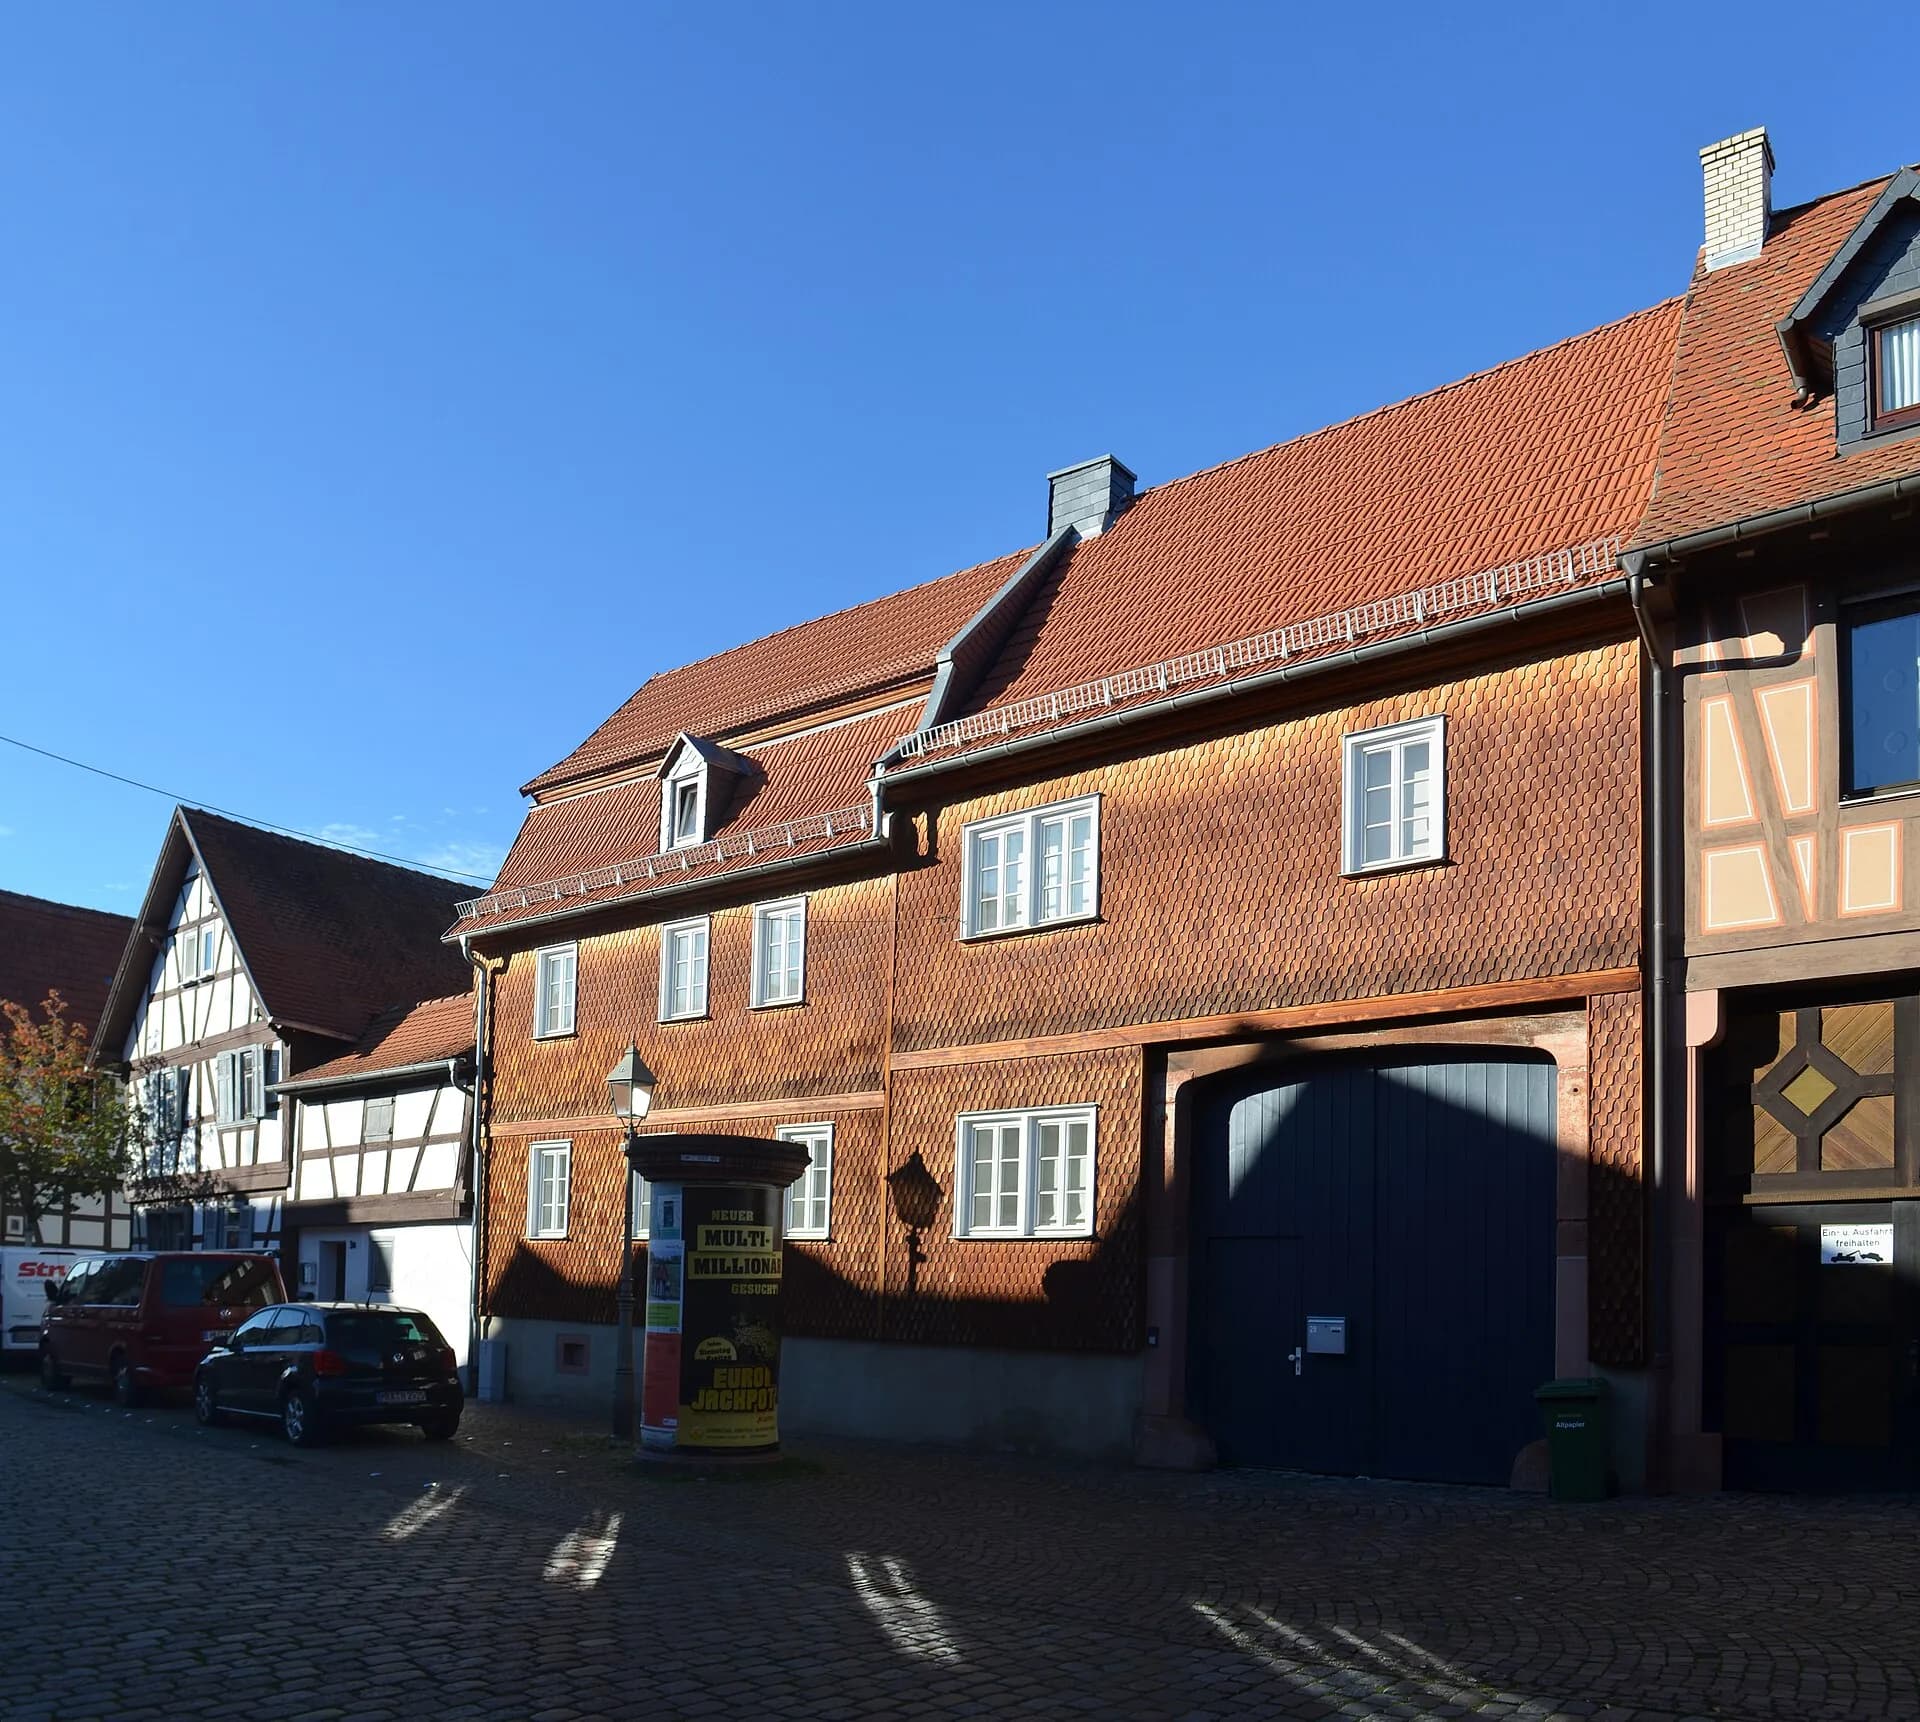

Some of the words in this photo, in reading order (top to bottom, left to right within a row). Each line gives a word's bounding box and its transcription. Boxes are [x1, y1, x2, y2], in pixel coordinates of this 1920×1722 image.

[711, 1209, 754, 1222] NEUER
[1852, 1228, 1893, 1236] Ausfahrt
[704, 1229, 770, 1247] MULTI-
[1836, 1239, 1880, 1248] freihalten
